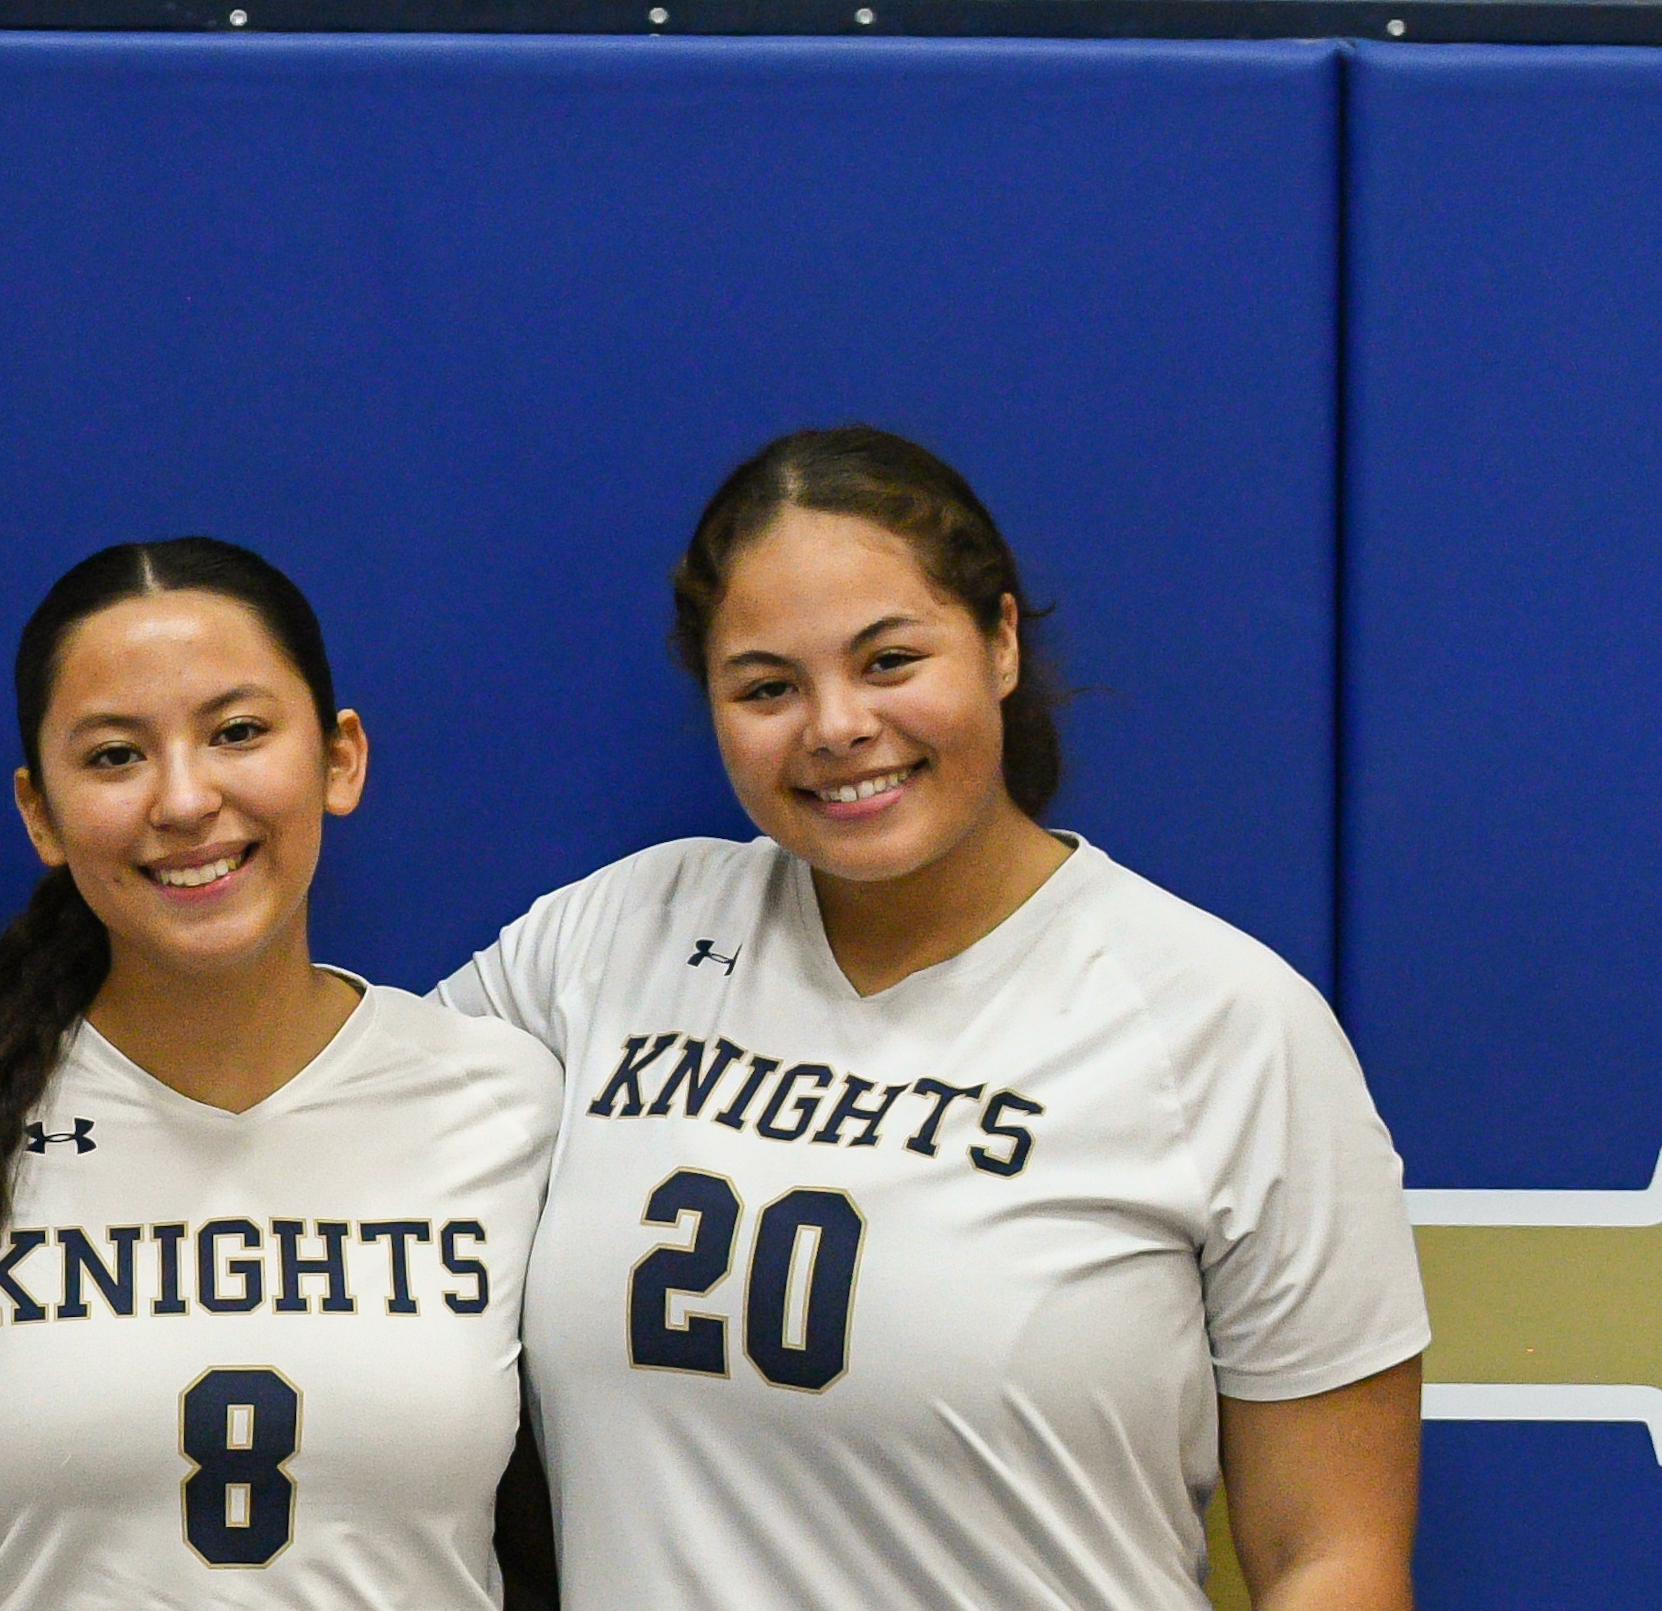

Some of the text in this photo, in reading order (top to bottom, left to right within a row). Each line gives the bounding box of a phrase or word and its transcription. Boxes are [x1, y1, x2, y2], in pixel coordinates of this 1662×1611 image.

[585, 1030, 1047, 1180] KNIGHTS
[625, 1165, 868, 1395] 20
[177, 1364, 304, 1570] 8
